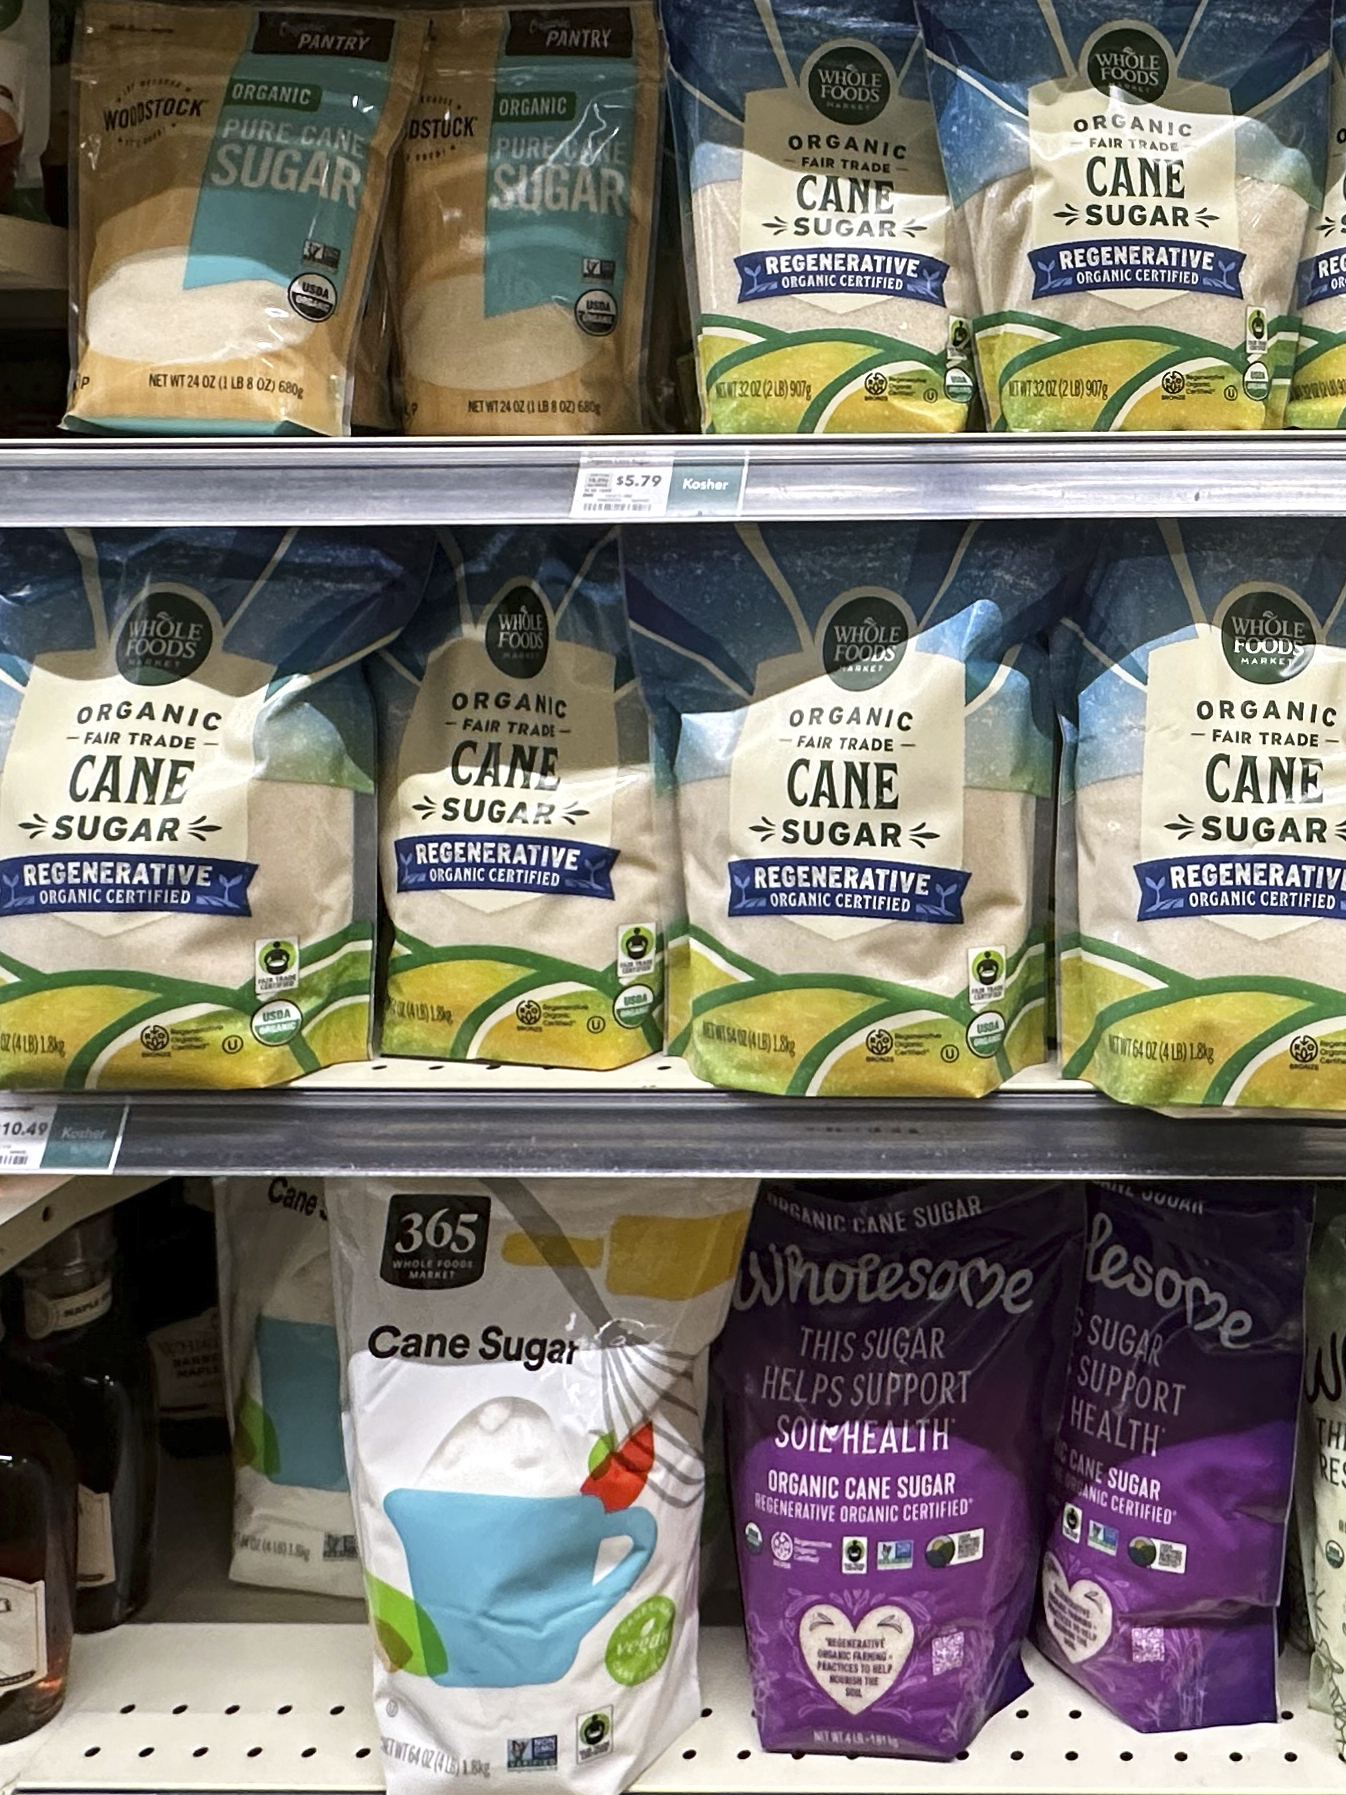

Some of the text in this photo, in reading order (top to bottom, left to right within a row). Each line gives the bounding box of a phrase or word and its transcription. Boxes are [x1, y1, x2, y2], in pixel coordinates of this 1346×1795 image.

[298, 34, 371, 50] PANTRY
[546, 29, 611, 47] PANTRY
[818, 68, 882, 88] WHOLE
[232, 83, 311, 104] ORGANIC
[821, 85, 879, 102] FOODS
[103, 98, 203, 131] WOODSTOCK
[500, 97, 566, 115] ORGANIC
[222, 118, 365, 159] PURE CANE
[788, 135, 907, 159] ORGANIC
[211, 143, 361, 209] SUGAR
[802, 157, 891, 173] FAIR TRADE
[1086, 156, 1185, 198] CANE
[493, 162, 625, 216] SUGAR
[797, 175, 894, 214] CANE
[794, 217, 896, 237] SUGAR
[1086, 204, 1189, 226] SUGAR
[765, 254, 920, 277] REGENERATIVE
[1059, 246, 1215, 270] REGENERATIVE
[782, 275, 903, 290] ORGANIC CERTIFIED
[1077, 269, 1198, 284] ORGANIC CERTIFIED
[302, 283, 329, 299] USDA
[150, 374, 167, 387] NET
[170, 375, 185, 387] WT
[188, 375, 200, 388] 24
[203, 375, 216, 389] OZ
[231, 376, 244, 389] LB
[247, 377, 253, 389] 8
[257, 377, 275, 393] OZ)
[1034, 381, 1045, 397] 32
[1047, 381, 1058, 398] OZ
[617, 475, 662, 487] $5.79
[683, 478, 728, 490] Kosher
[1231, 616, 1305, 638] WHOLE
[1234, 637, 1305, 656] FOODS
[1197, 700, 1337, 727] ORGANIC
[1213, 729, 1319, 747] FAIR TRADE
[451, 740, 560, 791] CANE
[70, 754, 194, 805] CANE
[788, 758, 899, 809] CANE
[1206, 753, 1323, 804] CANE
[442, 798, 555, 824] SUGAR
[52, 815, 180, 842] SUGAR
[782, 819, 901, 847] SUGAR
[1202, 816, 1327, 842] SUGAR
[416, 842, 581, 870] REGENERATIVE
[23, 862, 212, 886] REGENERATIVE
[754, 866, 930, 895] REGENERATIVE
[40, 889, 190, 904] ORGANIC CERTIFIED
[1189, 891, 1335, 910] ORGANIC CERTIFIED
[262, 1009, 290, 1021] USDA
[1146, 1042, 1157, 1060] OZ
[0, 1122, 48, 1135] 10.49
[395, 1208, 479, 1253] 365
[393, 1260, 473, 1268] WHOLE FOODS
[410, 1271, 455, 1279] MARKET
[733, 1243, 1034, 1314] Wholesome
[368, 1325, 579, 1371] Cane Sugar
[801, 1326, 946, 1365] THIS SUGAR
[762, 1366, 971, 1407] HELPS SUPPORT
[1077, 1355, 1186, 1416] SUPPORT
[775, 1414, 832, 1453] SOIL
[768, 1470, 955, 1499] ORGANIC CANE SUGAR
[1107, 1467, 1161, 1501] SUGAR
[755, 1493, 898, 1523] REGENERATIVE ORGANIC
